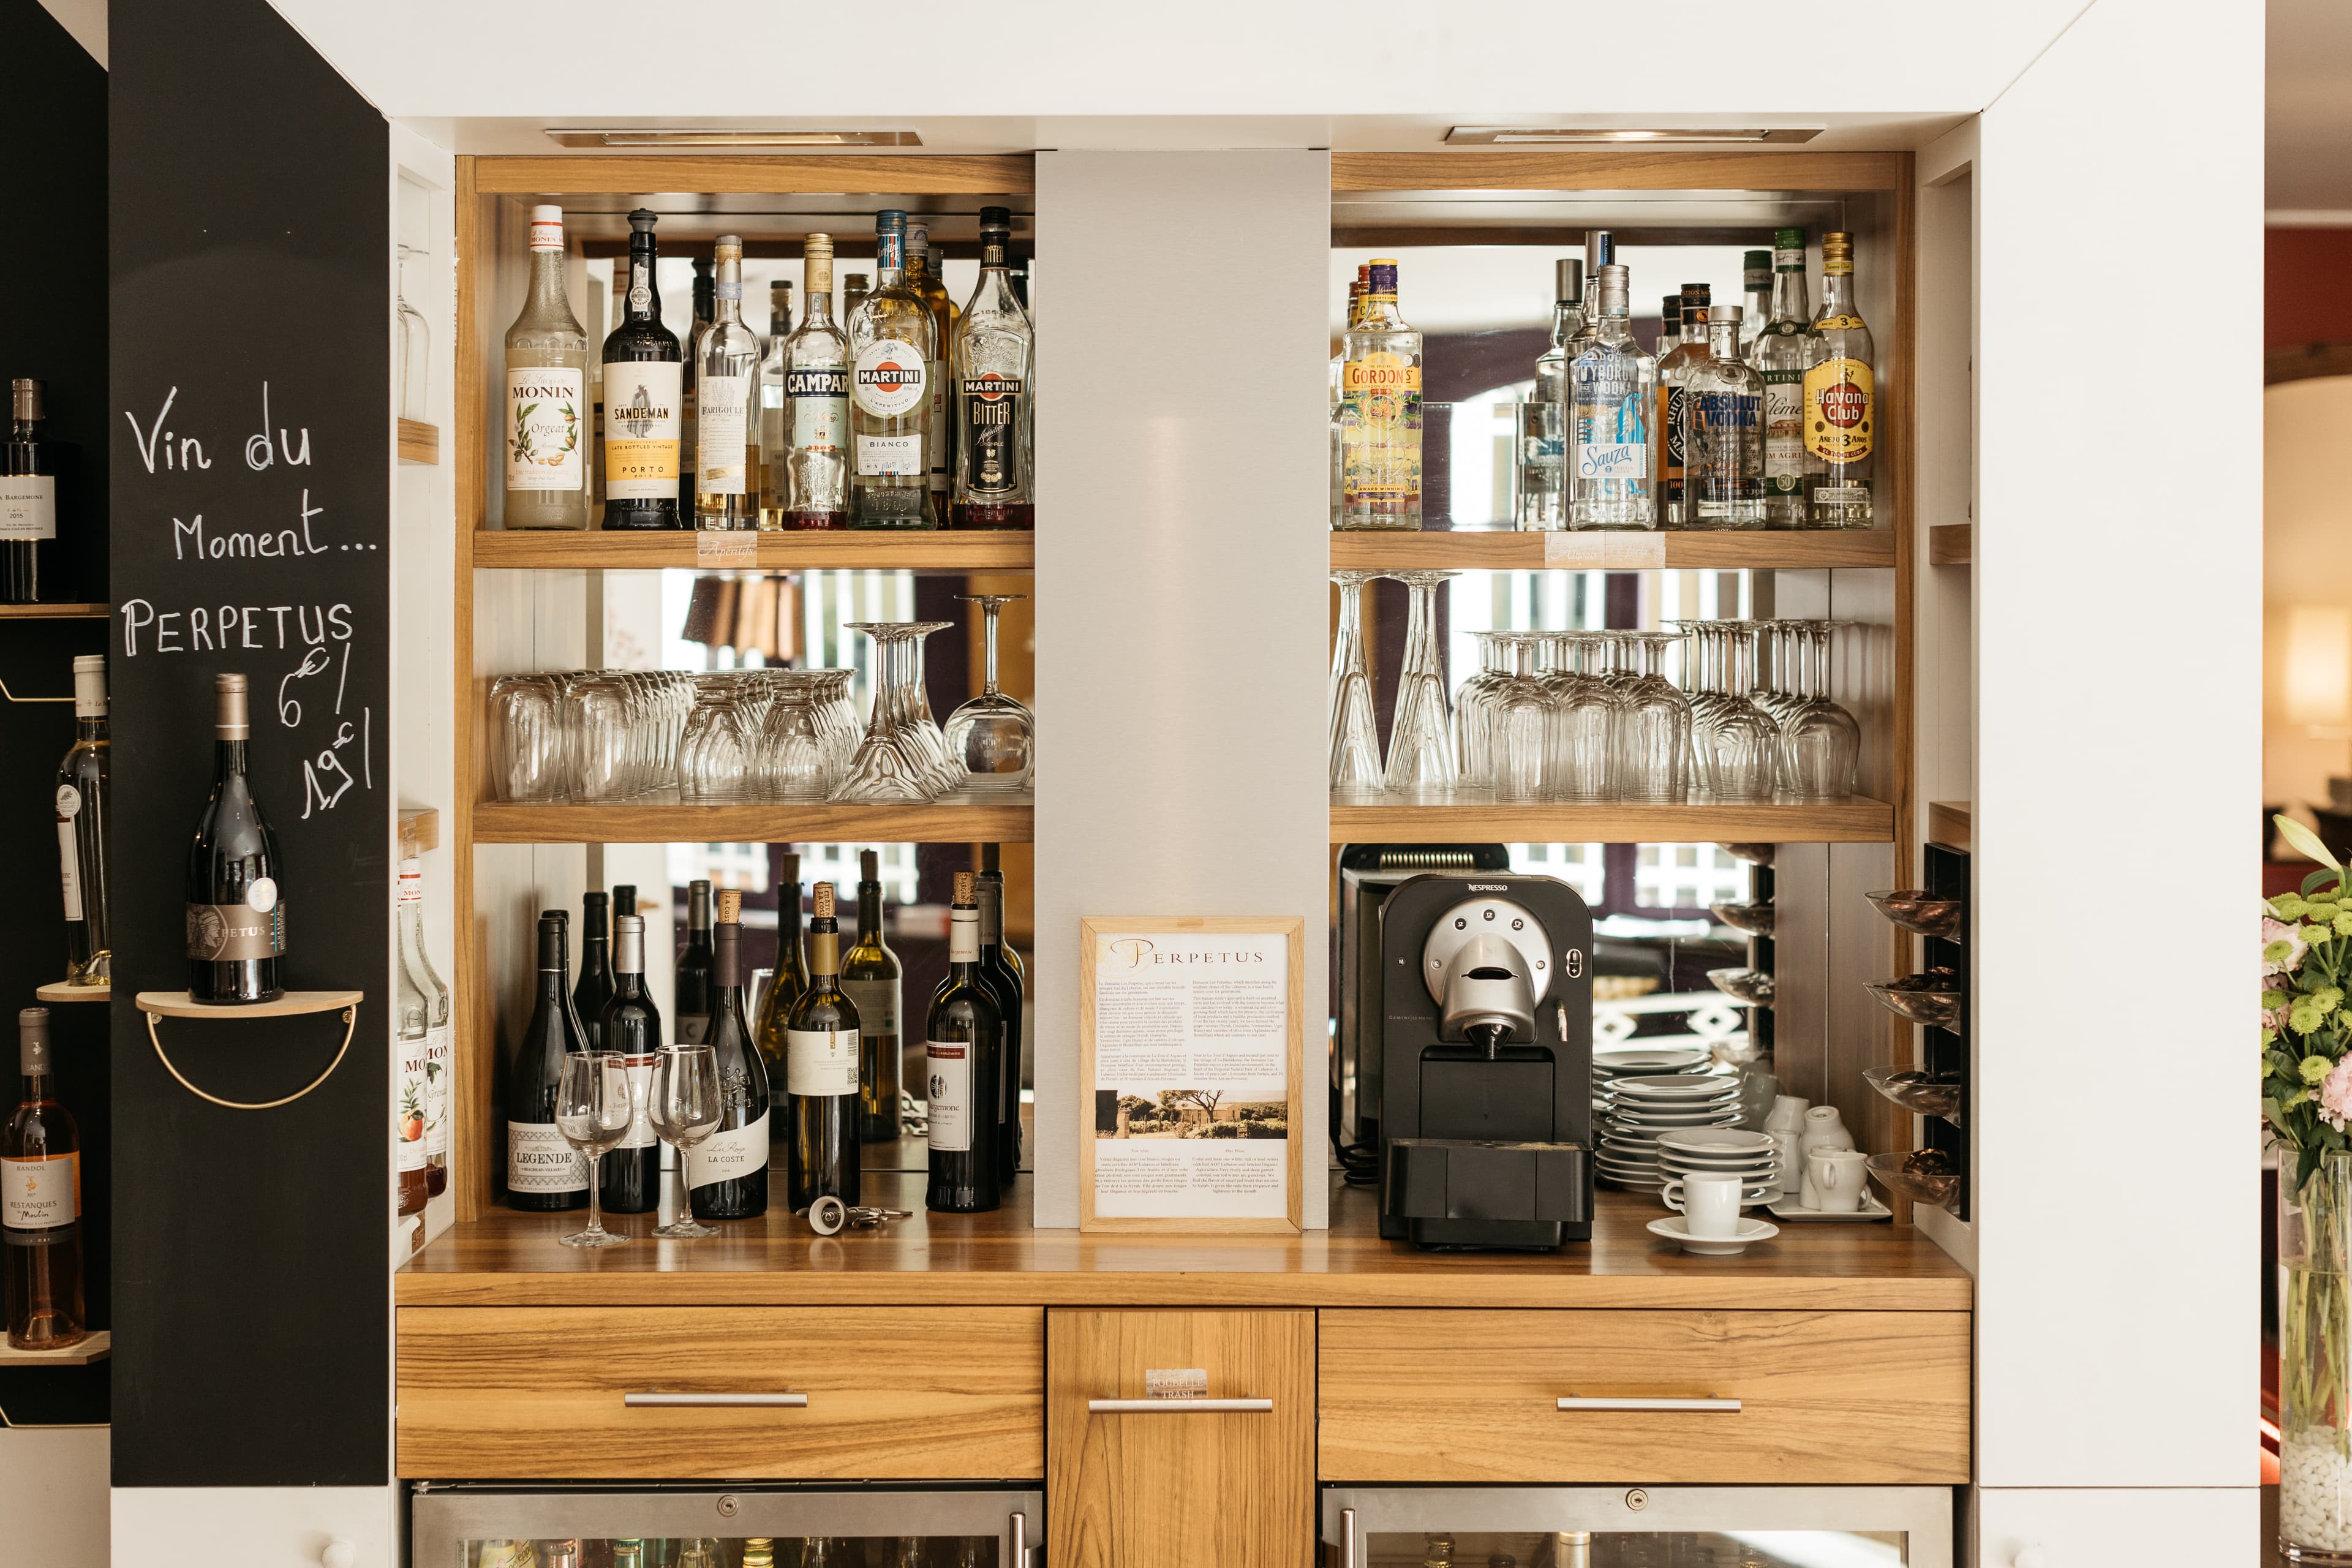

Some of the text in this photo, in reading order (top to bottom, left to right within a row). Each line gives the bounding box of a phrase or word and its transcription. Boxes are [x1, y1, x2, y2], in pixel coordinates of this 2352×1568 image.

[983, 249, 1003, 263] BITTER
[1841, 317, 1849, 326] 3
[861, 371, 918, 383] MARTINI
[1352, 368, 1411, 384] GORDON'S
[513, 386, 574, 399] MONIN
[965, 382, 1019, 391] MARTINI
[1700, 395, 1762, 411] ABSOLUT
[1816, 388, 1869, 404] Havana
[614, 407, 669, 420] SANDEMAN
[703, 406, 744, 415] FARIGOULE
[974, 402, 1009, 424] BITTER
[1828, 405, 1860, 421] Club
[1705, 411, 1757, 426] VODKA
[126, 381, 311, 473] Vin du
[531, 423, 564, 437] Orgeat
[976, 424, 1005, 445] Aperitivo
[1842, 434, 1851, 447] 3
[1852, 435, 1868, 443] AÑOS
[1582, 445, 1632, 475] Sauza
[122, 599, 353, 656] PERPETUS
[1110, 939, 1264, 968] PERPETUS
[517, 1153, 571, 1164] LEGENDE
[10, 1200, 57, 1209] RESTANQUES
[21, 1210, 49, 1221] Moulin
[1153, 1379, 1203, 1387] POUBELLE
